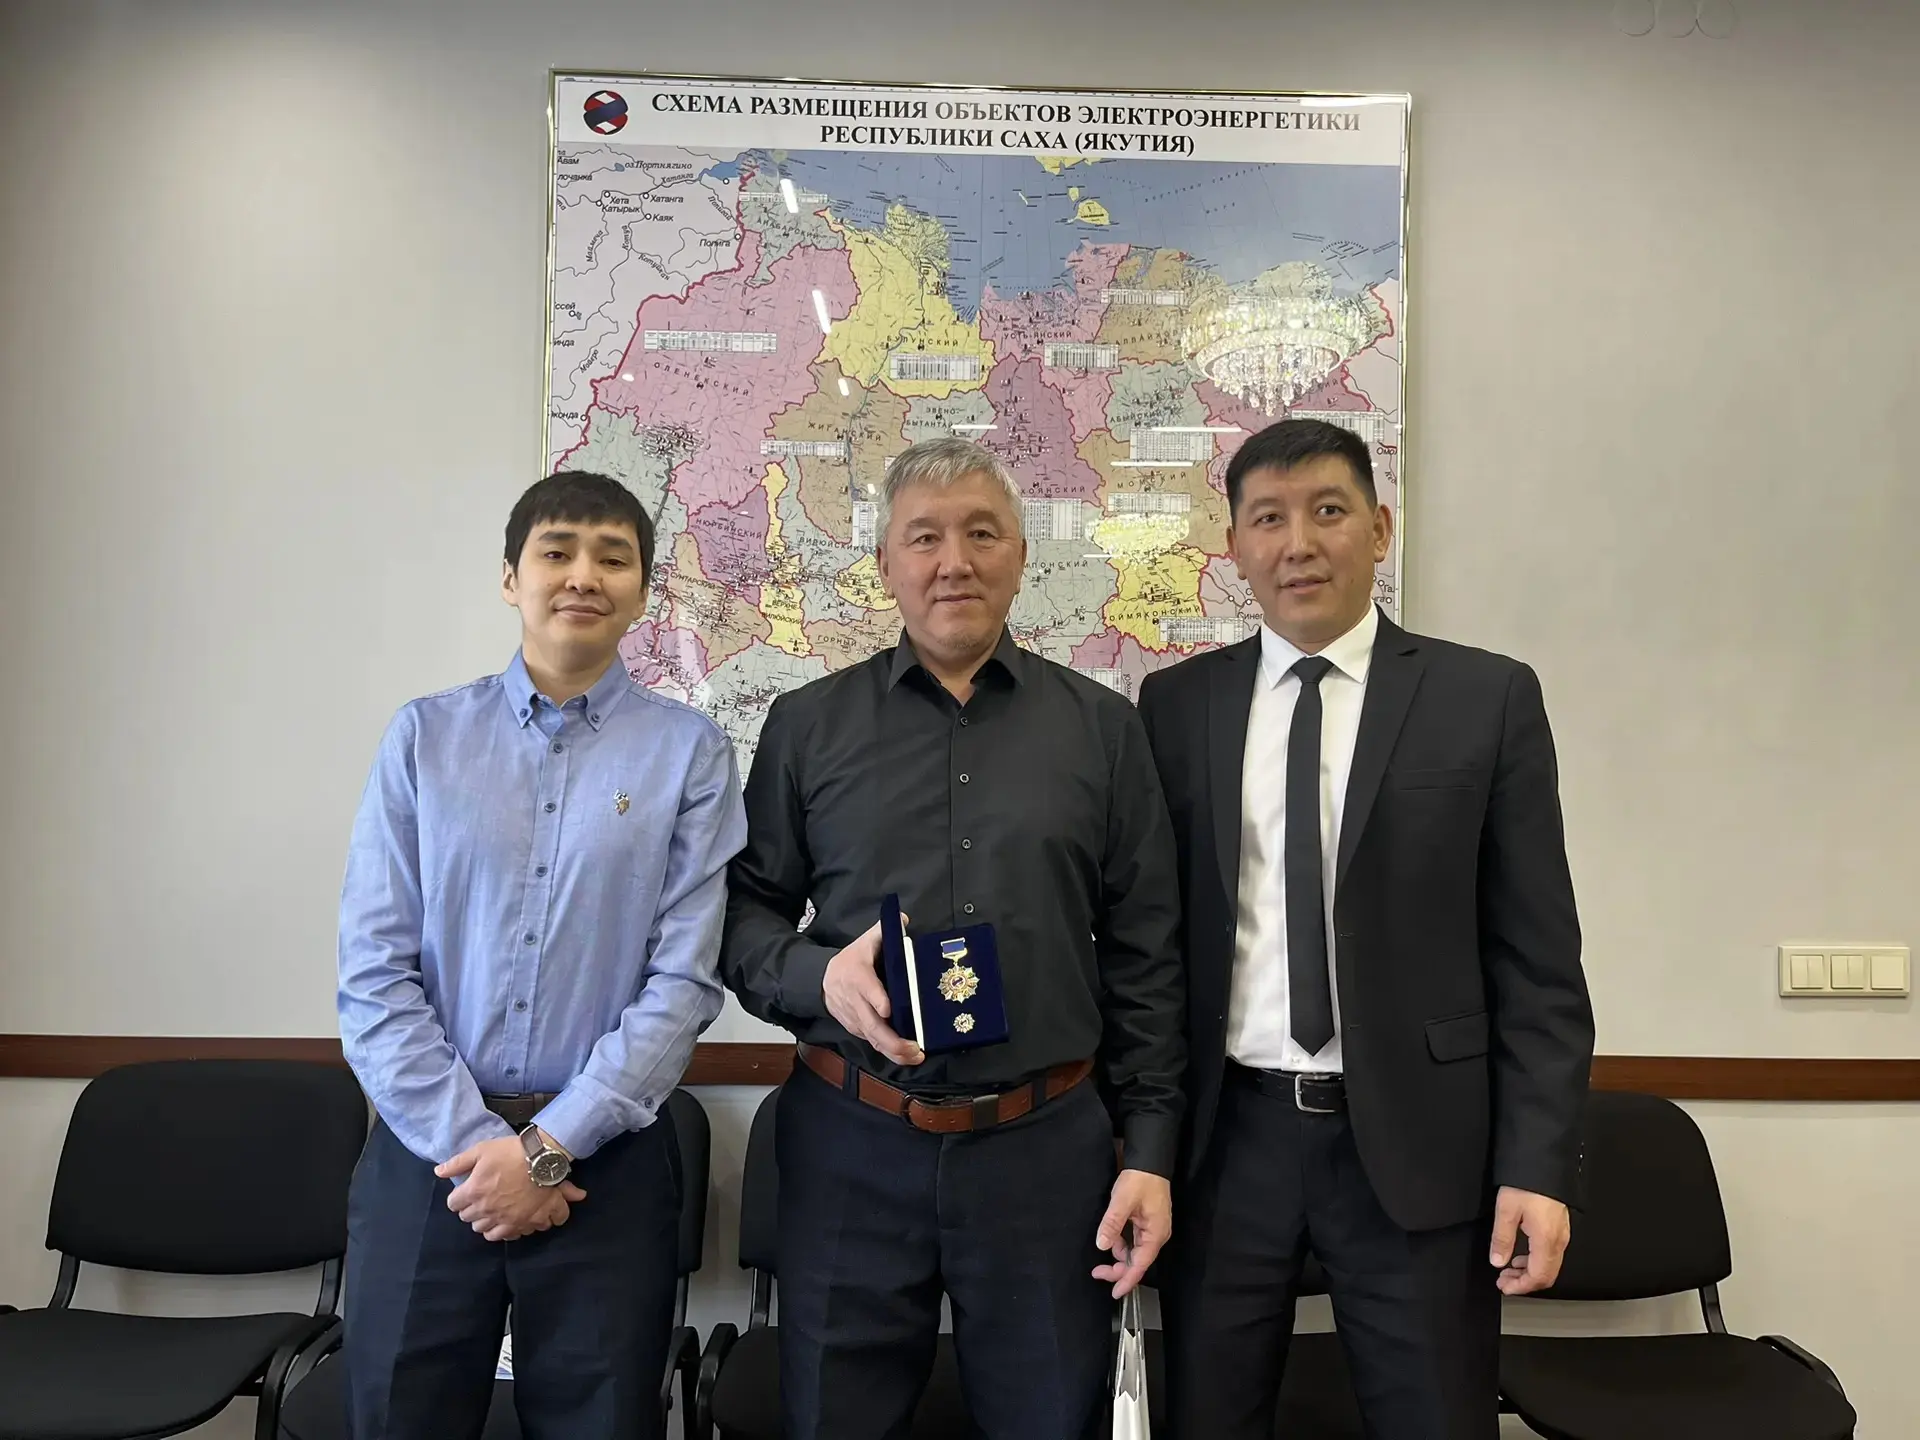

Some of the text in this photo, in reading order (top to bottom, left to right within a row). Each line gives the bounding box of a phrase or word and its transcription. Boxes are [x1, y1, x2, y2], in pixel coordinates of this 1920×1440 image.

[652, 93, 1361, 131] СХЕМА РАЗМЕЩЕНИЯ ОБЪЕКТОВ ЭЛЕКТРОЭНЕРГЕТИКИ
[820, 124, 1195, 157] РЕСПУБЛИКИ САХА (ЯКУТИЯ)
[650, 195, 684, 203] Хатанга
[602, 205, 640, 214] Катырык
[652, 214, 674, 222] Каяк
[554, 302, 576, 310] ссей
